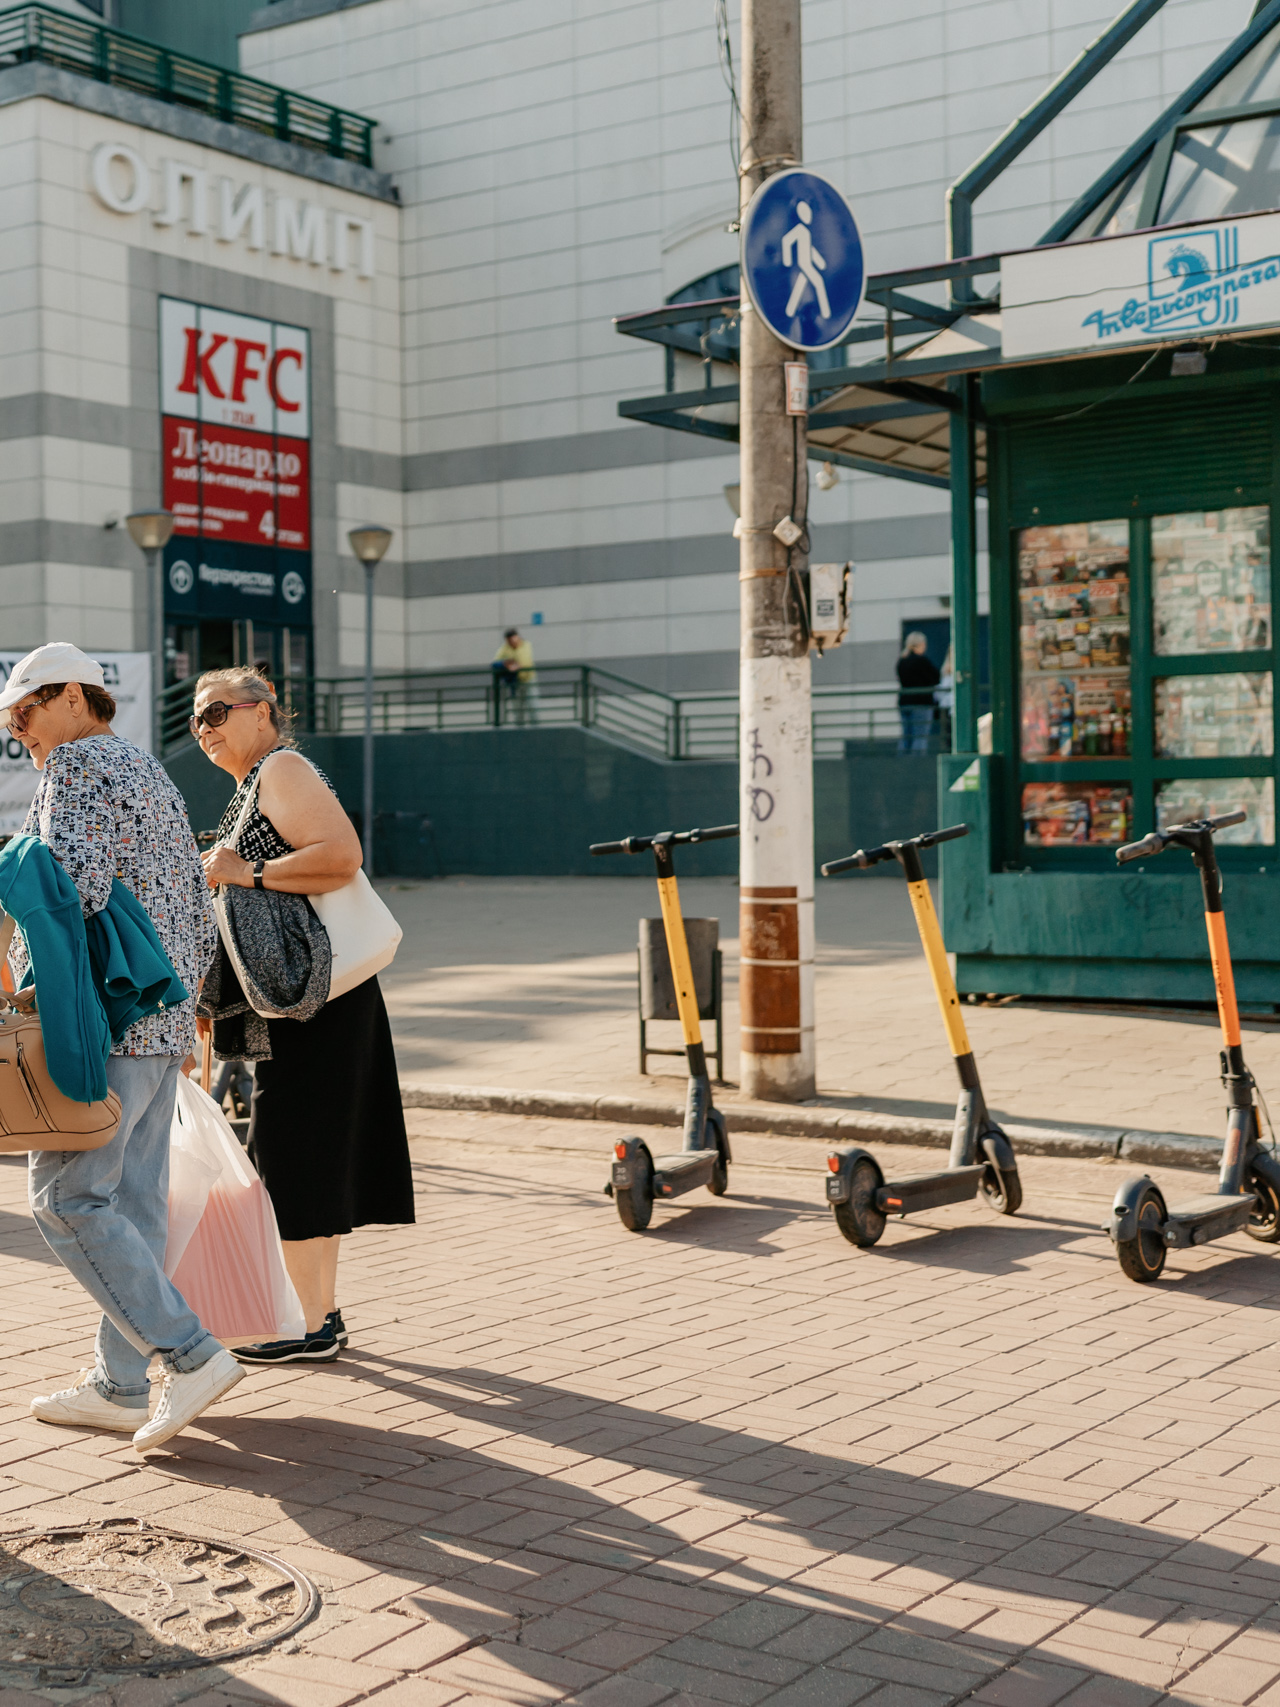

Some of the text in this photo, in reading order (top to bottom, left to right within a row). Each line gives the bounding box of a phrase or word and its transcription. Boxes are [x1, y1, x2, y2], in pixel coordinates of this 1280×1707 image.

[91, 142, 376, 279] ОЛИМП
[177, 327, 302, 412] KFC
[172, 426, 301, 479] Леонардо
[259, 510, 276, 539] 4
